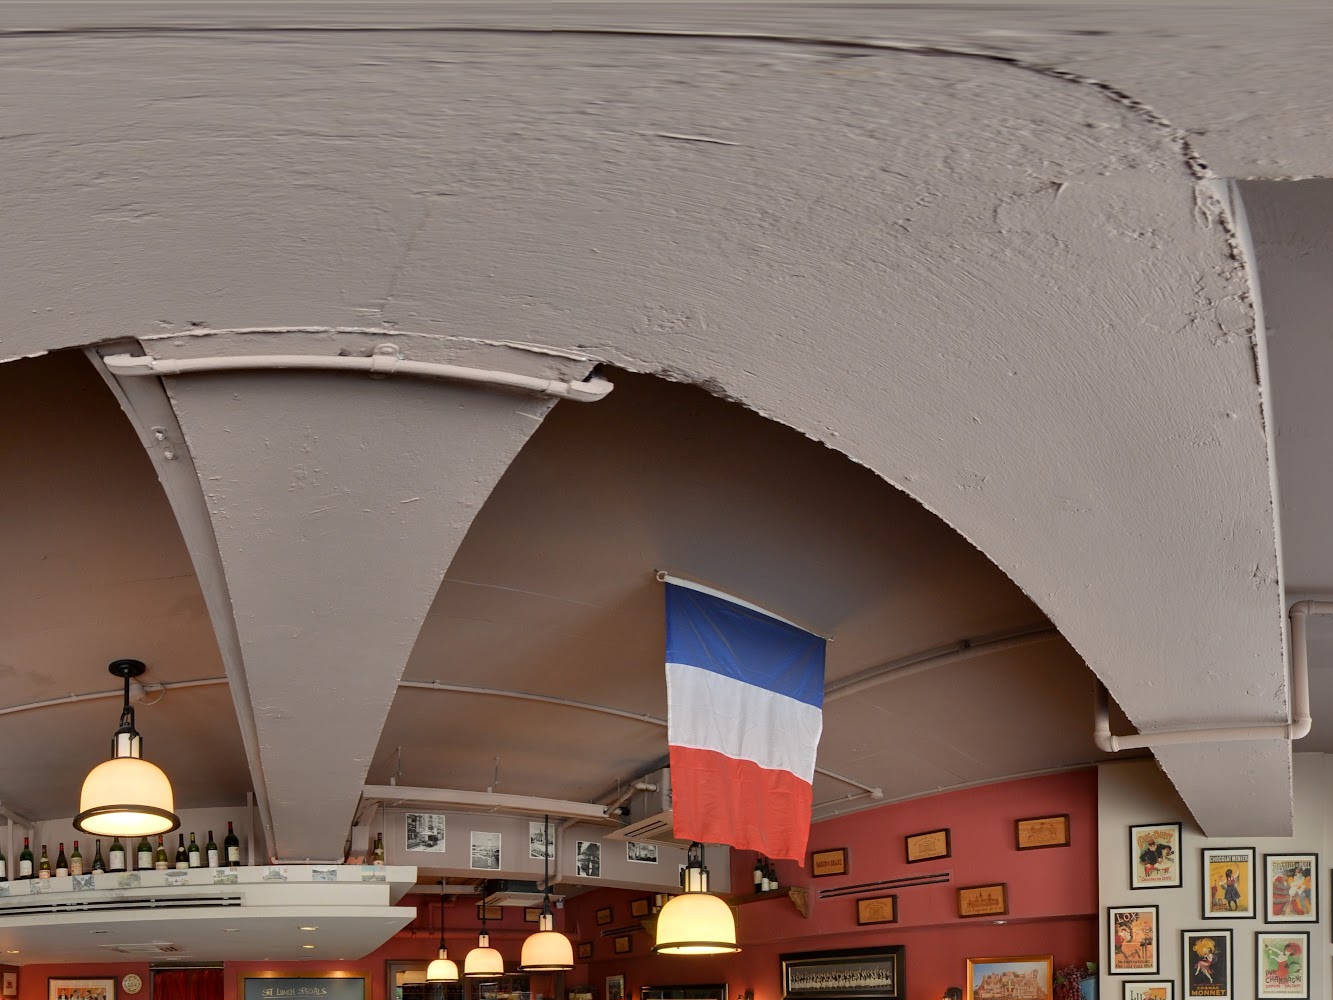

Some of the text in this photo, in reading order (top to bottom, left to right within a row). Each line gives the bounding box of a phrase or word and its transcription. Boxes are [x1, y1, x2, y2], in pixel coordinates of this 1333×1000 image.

[1116, 912, 1137, 922] LOX
[276, 988, 295, 996] LUNCH
[298, 987, 327, 995] SPECIALS
